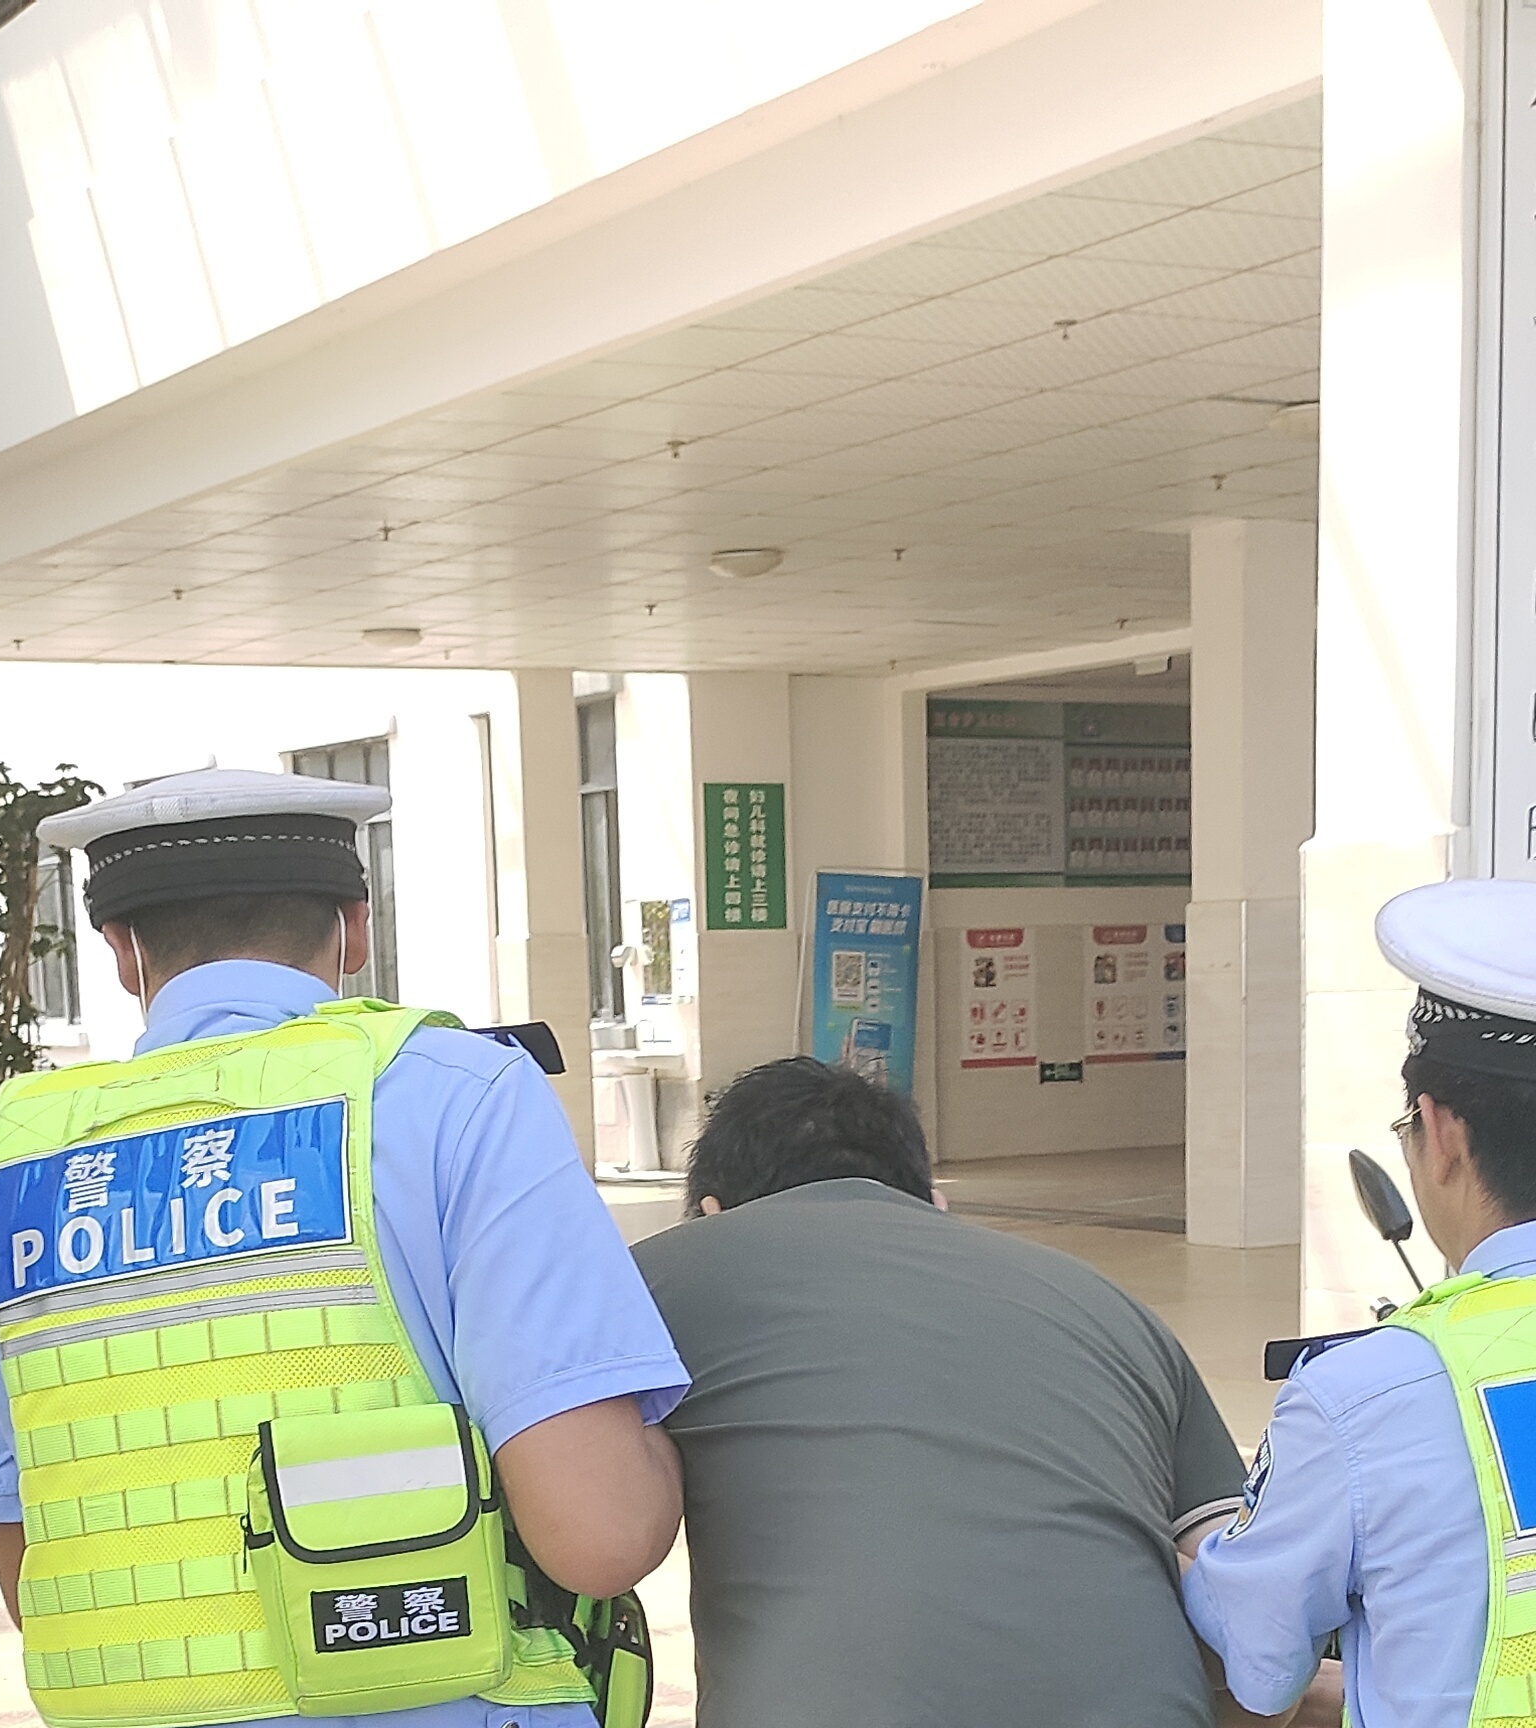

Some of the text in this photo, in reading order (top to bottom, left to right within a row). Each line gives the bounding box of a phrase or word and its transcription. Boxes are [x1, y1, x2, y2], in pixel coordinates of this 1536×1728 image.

[64, 1129, 235, 1213] 警察
[11, 1178, 299, 1289] POLICE
[325, 1609, 460, 1645] POLICE
[333, 1586, 446, 1622] 警察
